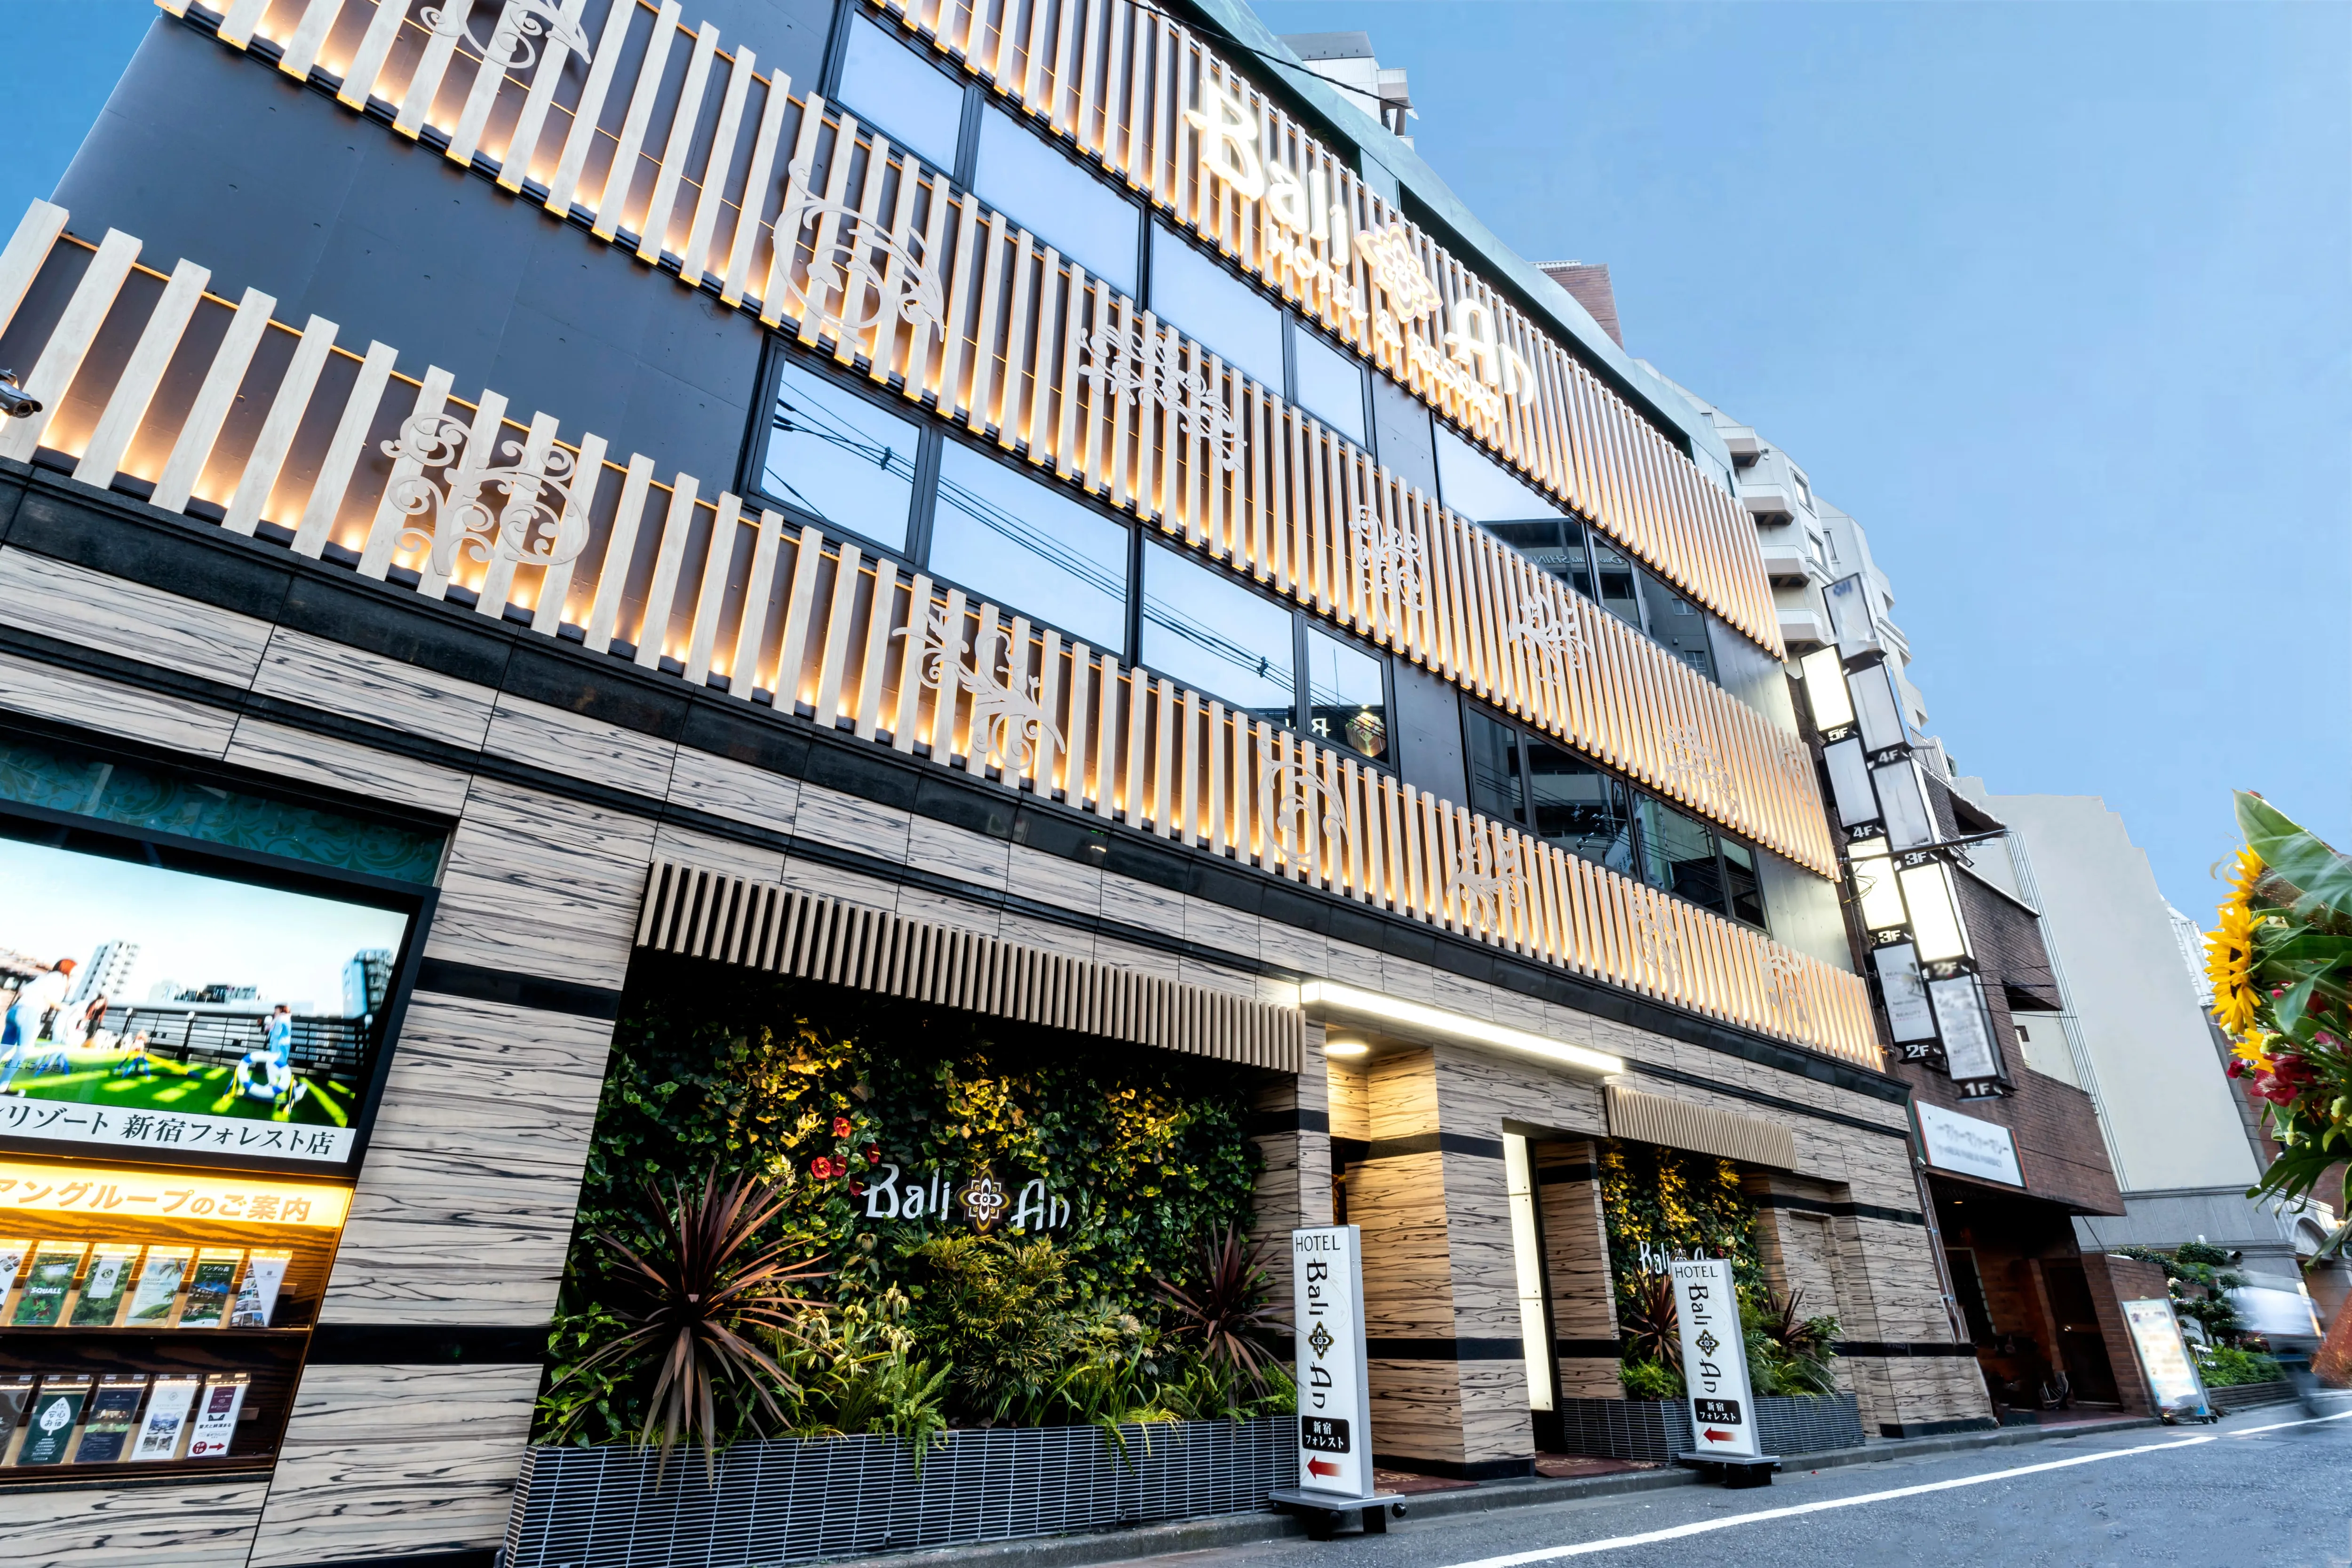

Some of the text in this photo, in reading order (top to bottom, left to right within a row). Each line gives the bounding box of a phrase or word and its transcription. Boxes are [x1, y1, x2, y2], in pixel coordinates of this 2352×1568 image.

[1184, 77, 1535, 406] Bali An
[1267, 223, 1369, 322] HOTEL
[1407, 332, 1502, 422] RESORT
[1828, 727, 1848, 741] 5F
[1878, 749, 1899, 763] 4F
[1853, 824, 1873, 838] 4F
[1905, 852, 1927, 866] 3F
[1878, 928, 1900, 943] 3F
[1906, 1044, 1929, 1059] 2F
[1964, 1082, 1990, 1097] 1F
[0, 1105, 335, 1155] リゾート 新宿フォレスト店
[860, 1163, 1070, 1231] Bali An
[1295, 1235, 1341, 1252] HOTEL
[1675, 1266, 1718, 1279] HOTEL
[1306, 1258, 1333, 1409] Bali An
[1688, 1282, 1722, 1393] Bali An
[1707, 1401, 1724, 1412] 新宿
[1700, 1411, 1736, 1422] フォレスト
[1313, 1420, 1332, 1435] 新宿
[1305, 1434, 1344, 1449] フォレスト
